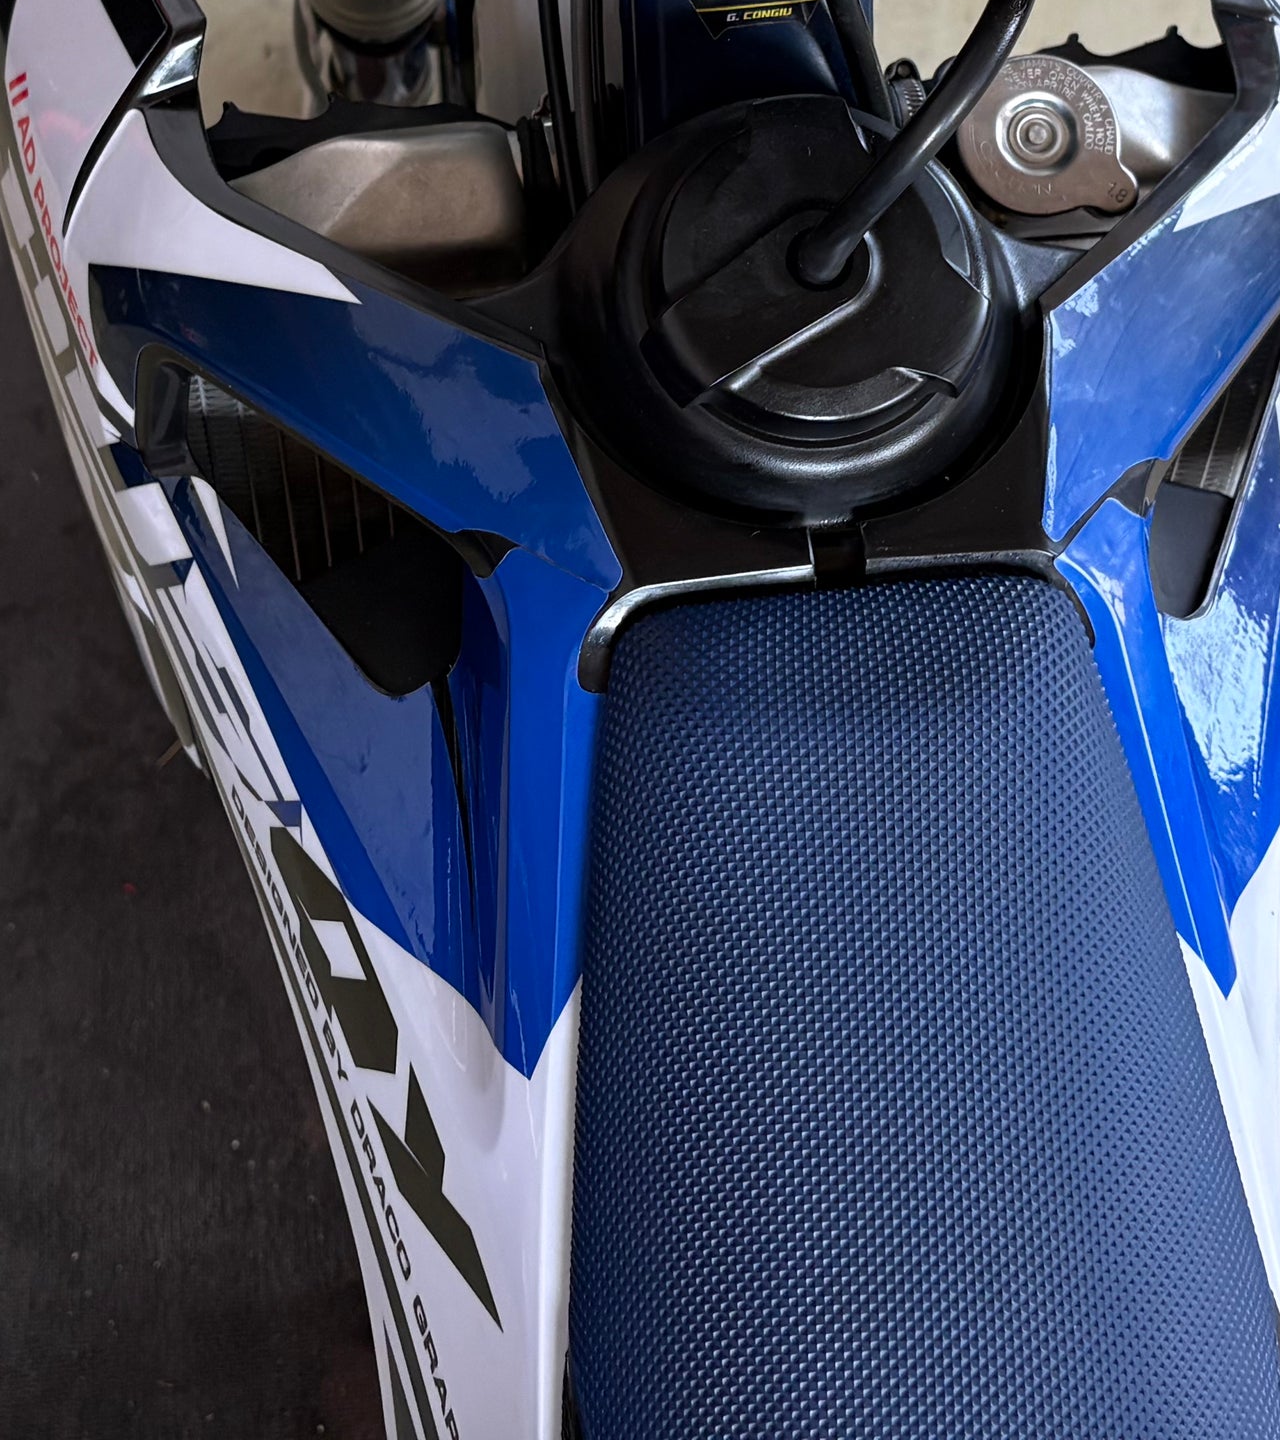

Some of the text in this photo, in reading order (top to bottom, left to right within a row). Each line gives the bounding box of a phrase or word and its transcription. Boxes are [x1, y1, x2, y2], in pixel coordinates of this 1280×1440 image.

[743, 7, 793, 21] CONGIU
[1049, 70, 1080, 90] OPEN
[1081, 90, 1103, 122] WHEN
[16, 117, 36, 174] AD
[32, 185, 100, 367] PROJECT
[231, 783, 320, 1011] DESIGNED
[322, 1019, 349, 1081] BY
[350, 1097, 413, 1283] DRACO
